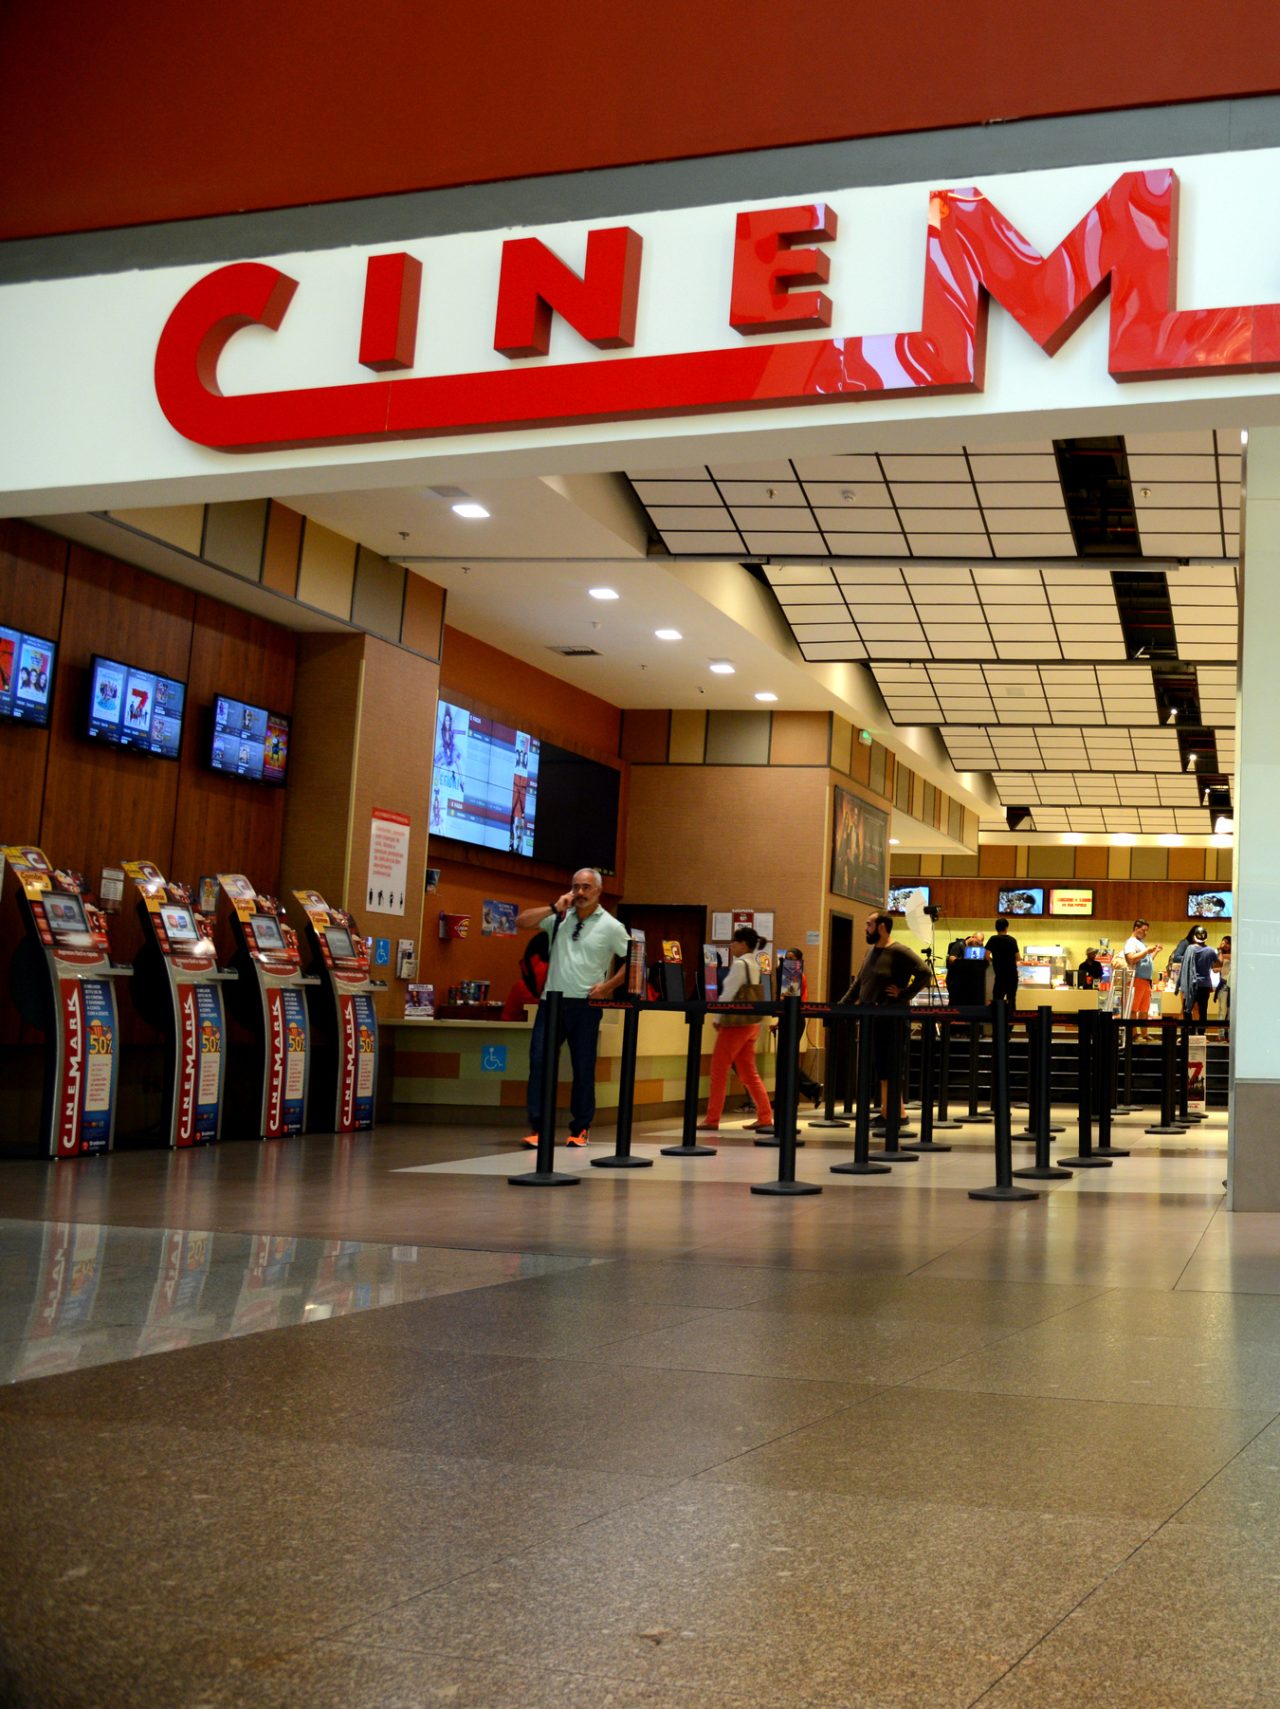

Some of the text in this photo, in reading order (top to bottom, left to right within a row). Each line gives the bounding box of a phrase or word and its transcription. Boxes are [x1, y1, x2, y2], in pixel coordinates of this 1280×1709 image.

[63, 988, 82, 1149] CINEMARK
[89, 1034, 113, 1054] 50%
[181, 992, 197, 1139] CINEMARK
[269, 996, 284, 1131] CINEMARK
[343, 1000, 356, 1126] CINEMARK
